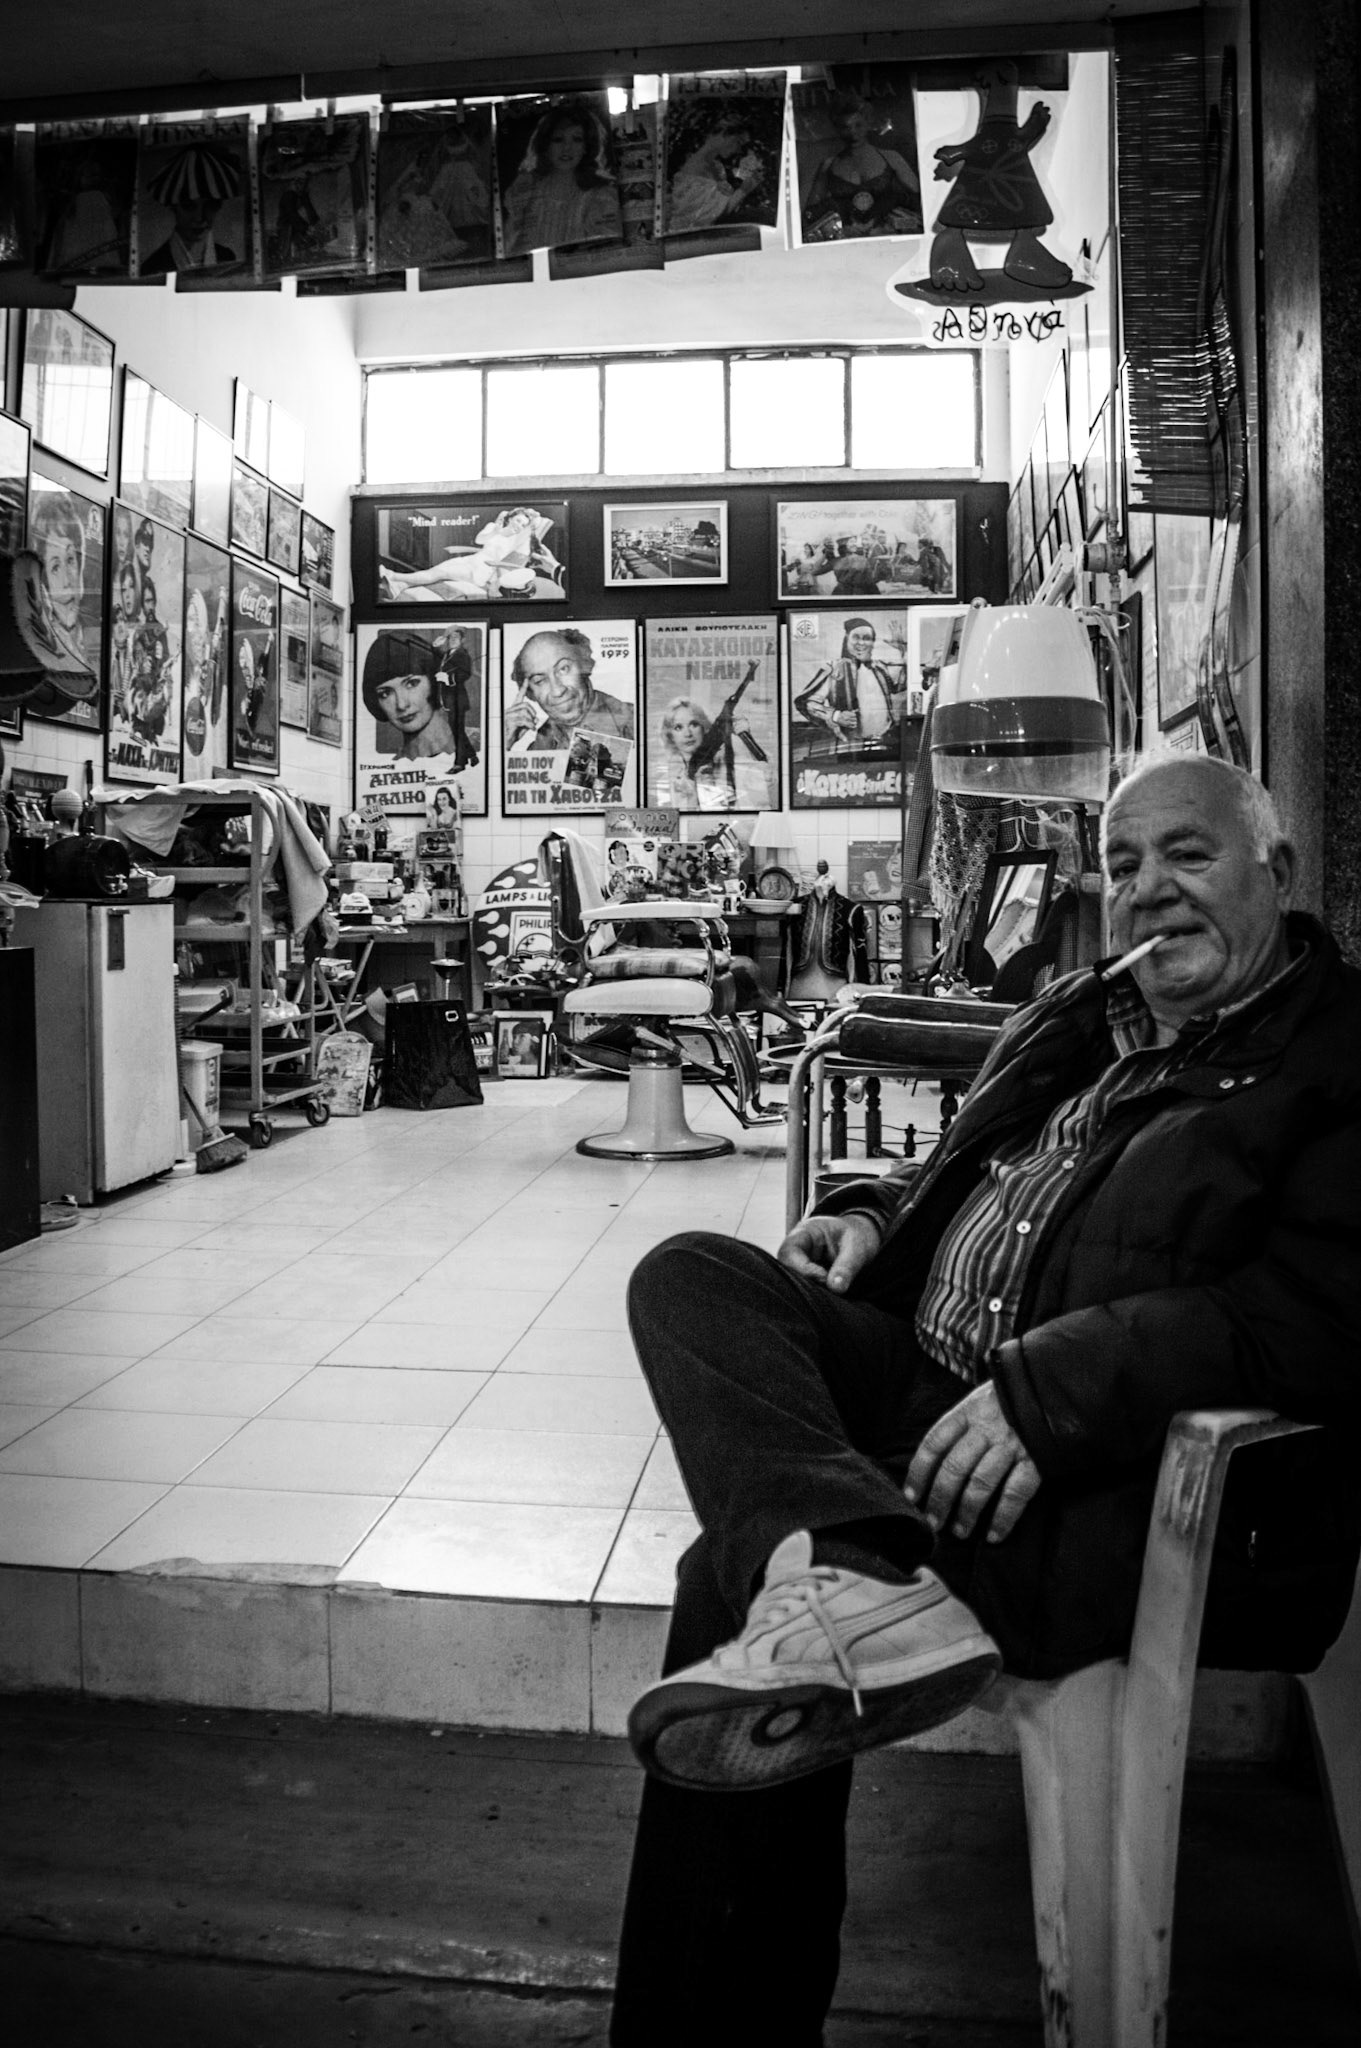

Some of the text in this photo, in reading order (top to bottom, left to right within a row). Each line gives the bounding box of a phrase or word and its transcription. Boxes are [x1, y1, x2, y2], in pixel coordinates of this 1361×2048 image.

[650, 636, 776, 658] ΚΑΤΑΣΚΟΠΟΣ
[601, 649, 629, 659] 1979
[507, 757, 554, 769] ΑΠΟ ΠΟΥ
[370, 770, 428, 788] ΑΓΑΠΗ
[507, 790, 527, 804] ΓΙΑ
[530, 790, 547, 804] ΤΗ
[486, 892, 527, 905] LAMPS
[520, 919, 552, 929] PHILIP
